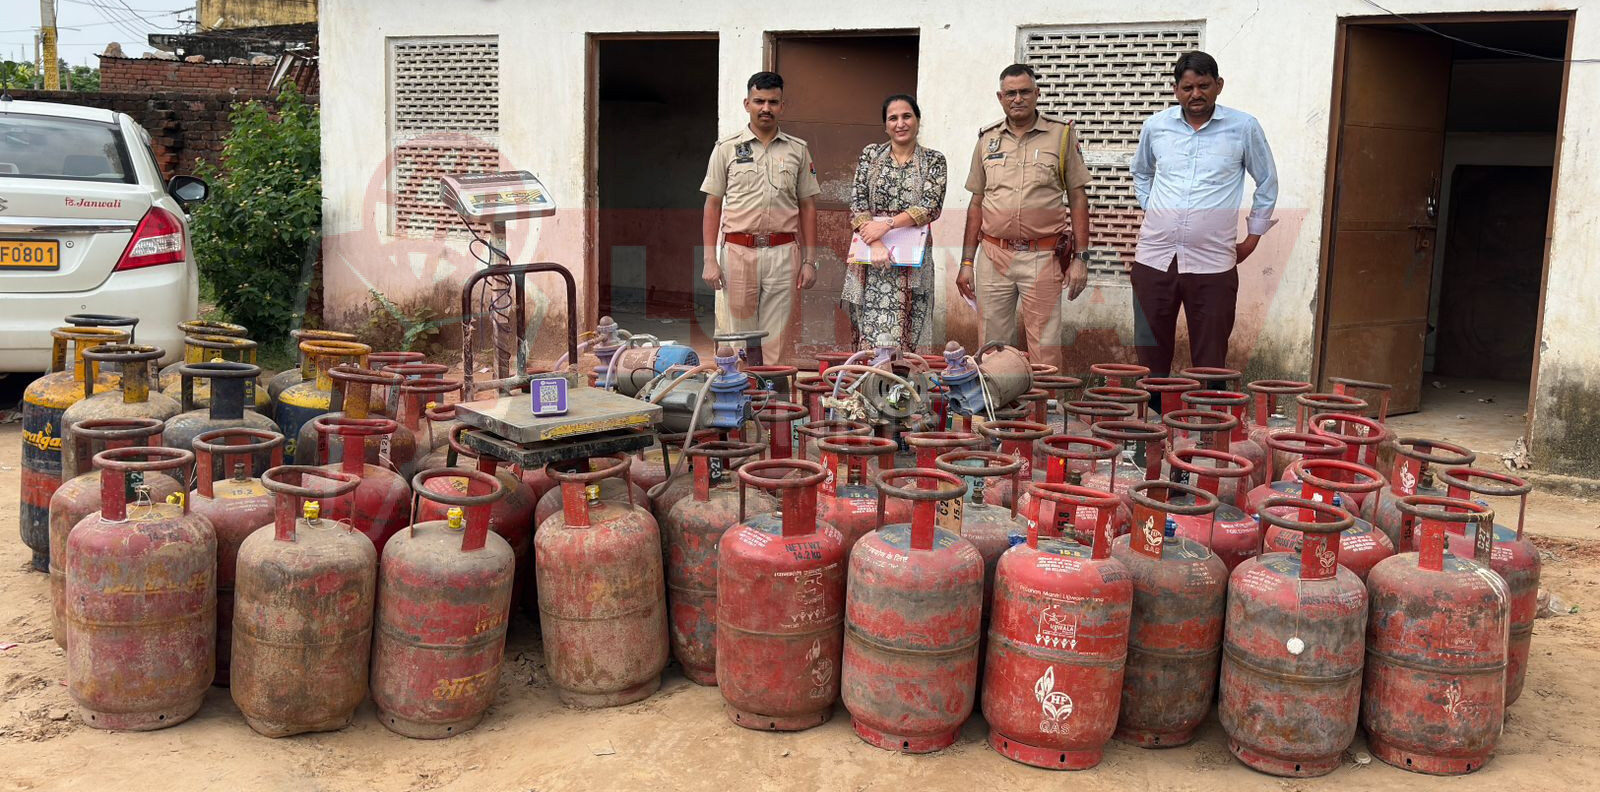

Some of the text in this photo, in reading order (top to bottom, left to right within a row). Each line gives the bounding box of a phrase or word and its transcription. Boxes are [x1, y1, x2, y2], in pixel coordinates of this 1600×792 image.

[77, 198, 121, 208] Janwali
[0, 246, 53, 264] F0801
[1039, 719, 1070, 735] GAS
